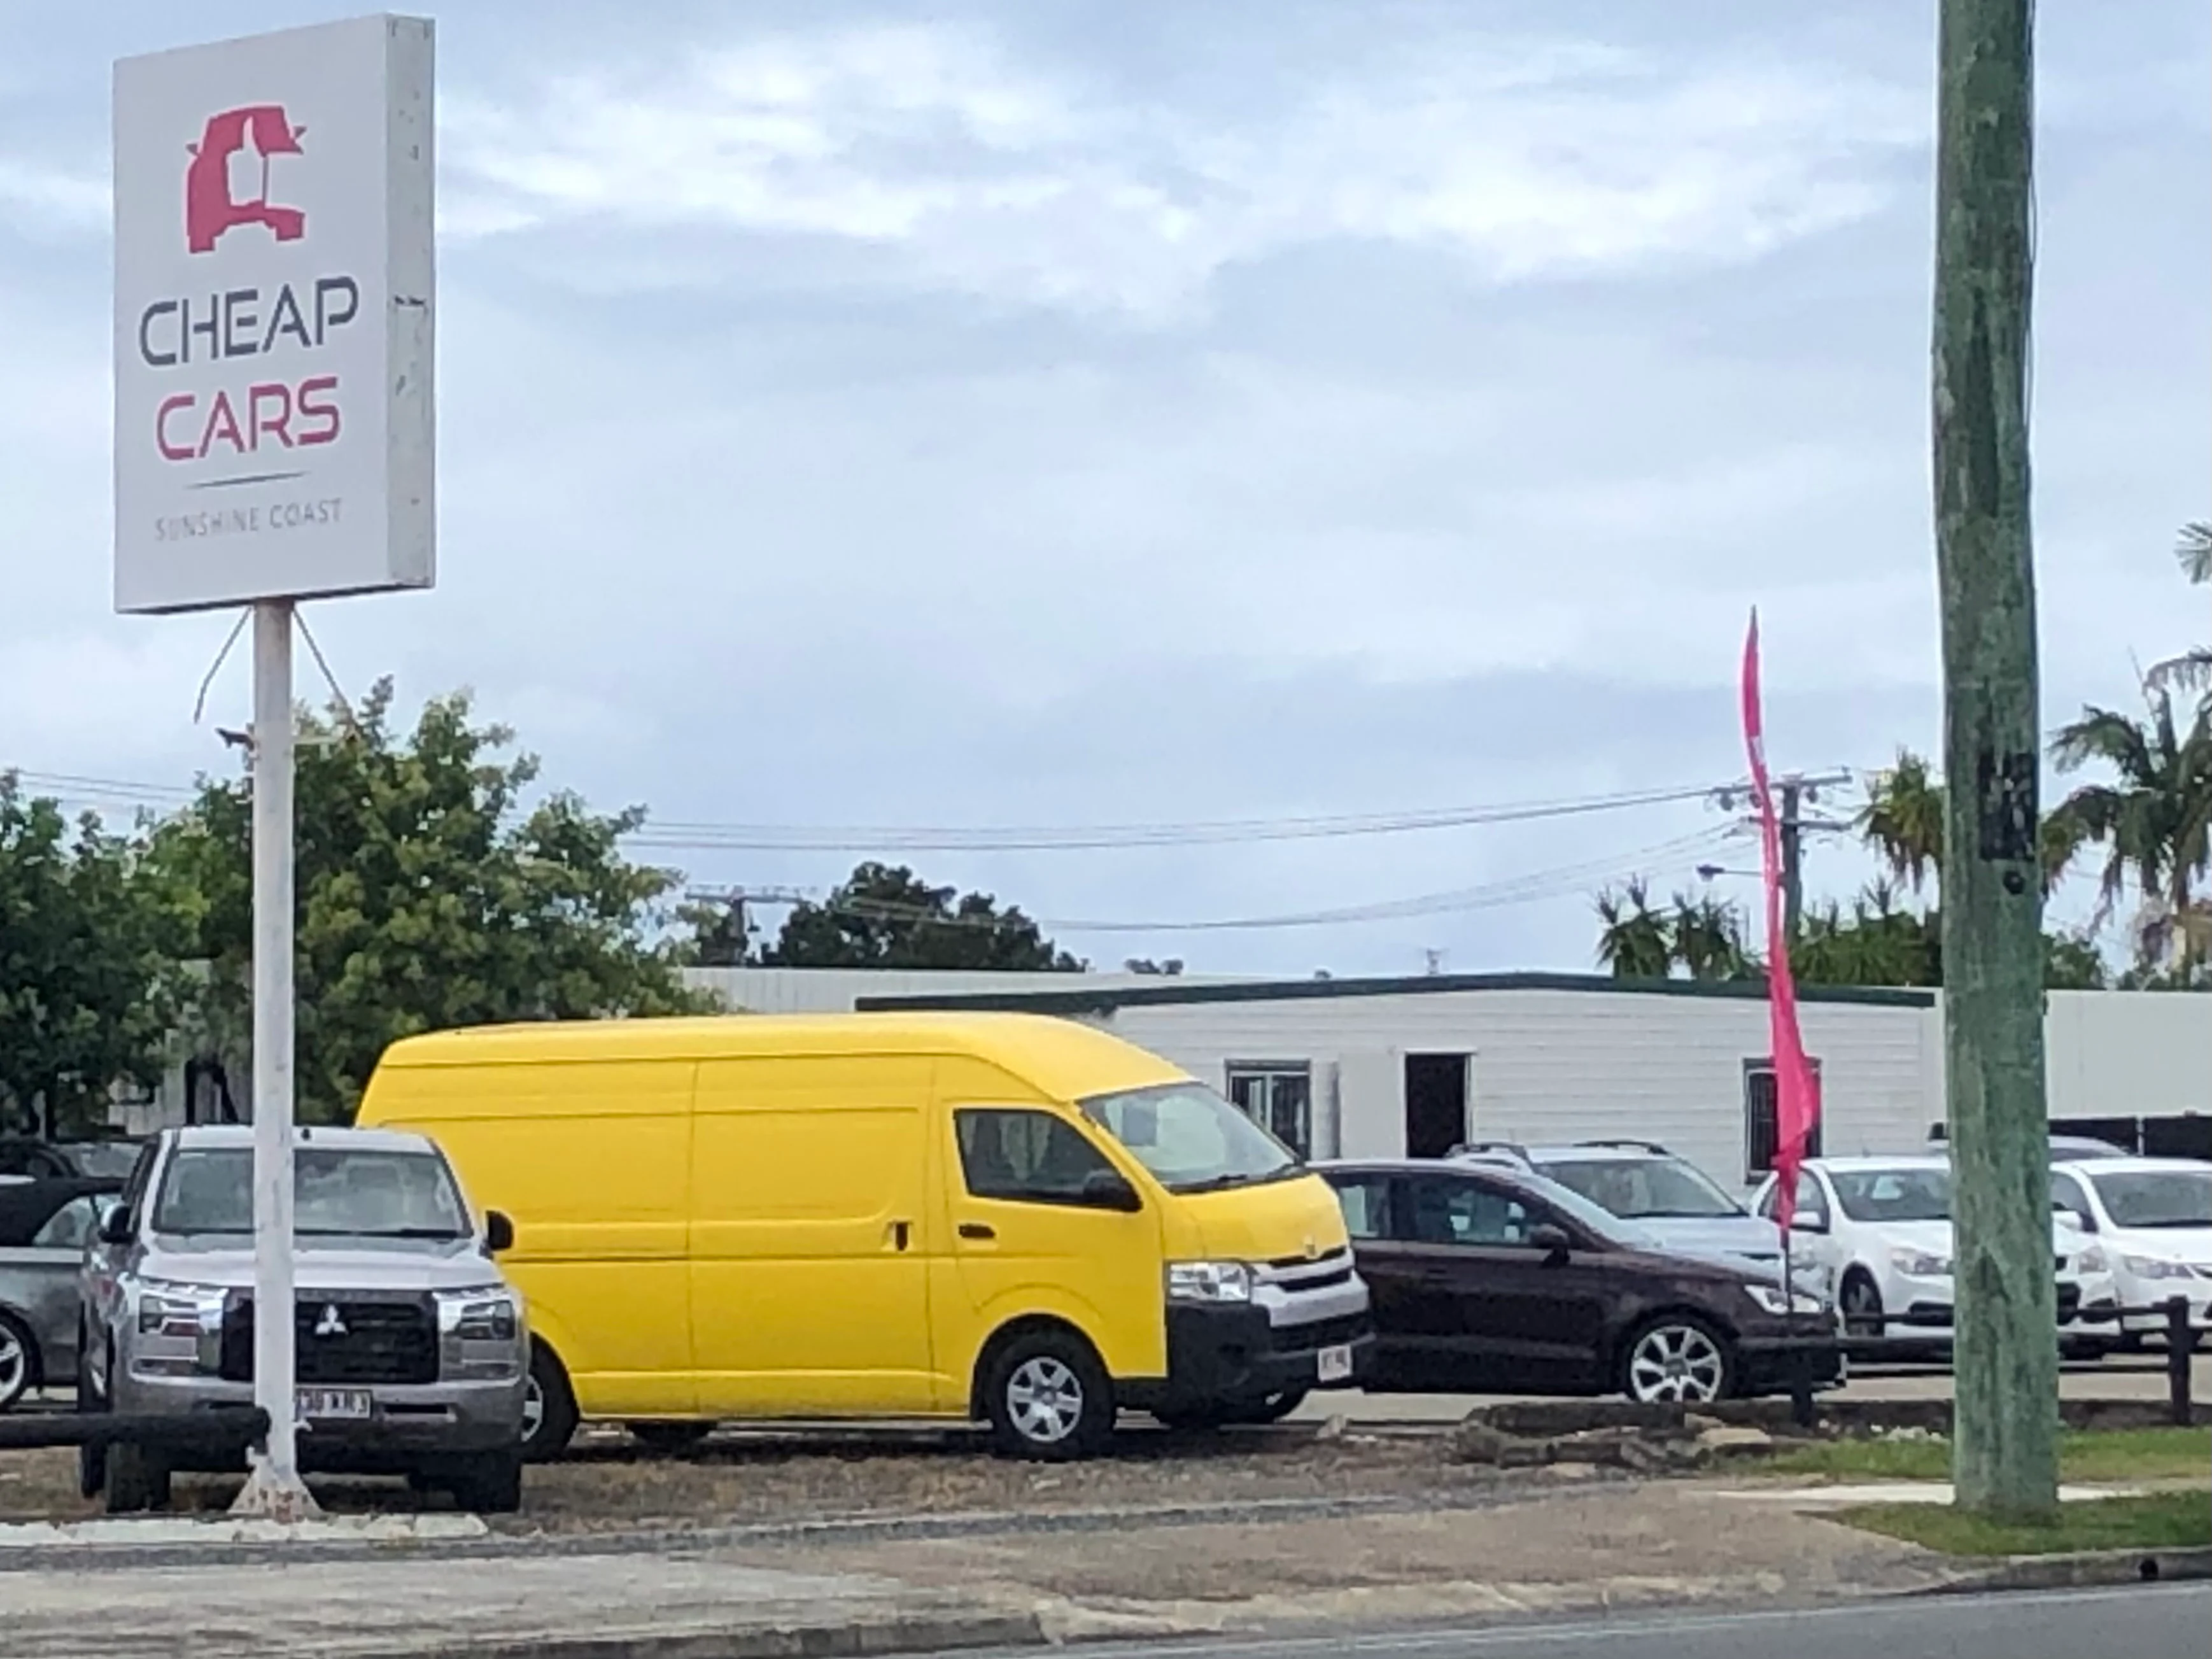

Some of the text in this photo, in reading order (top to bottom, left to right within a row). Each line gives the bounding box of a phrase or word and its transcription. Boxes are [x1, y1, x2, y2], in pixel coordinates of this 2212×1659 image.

[140, 276, 358, 366] CHEAP
[157, 376, 340, 460] CARS
[270, 497, 341, 528] COAST
